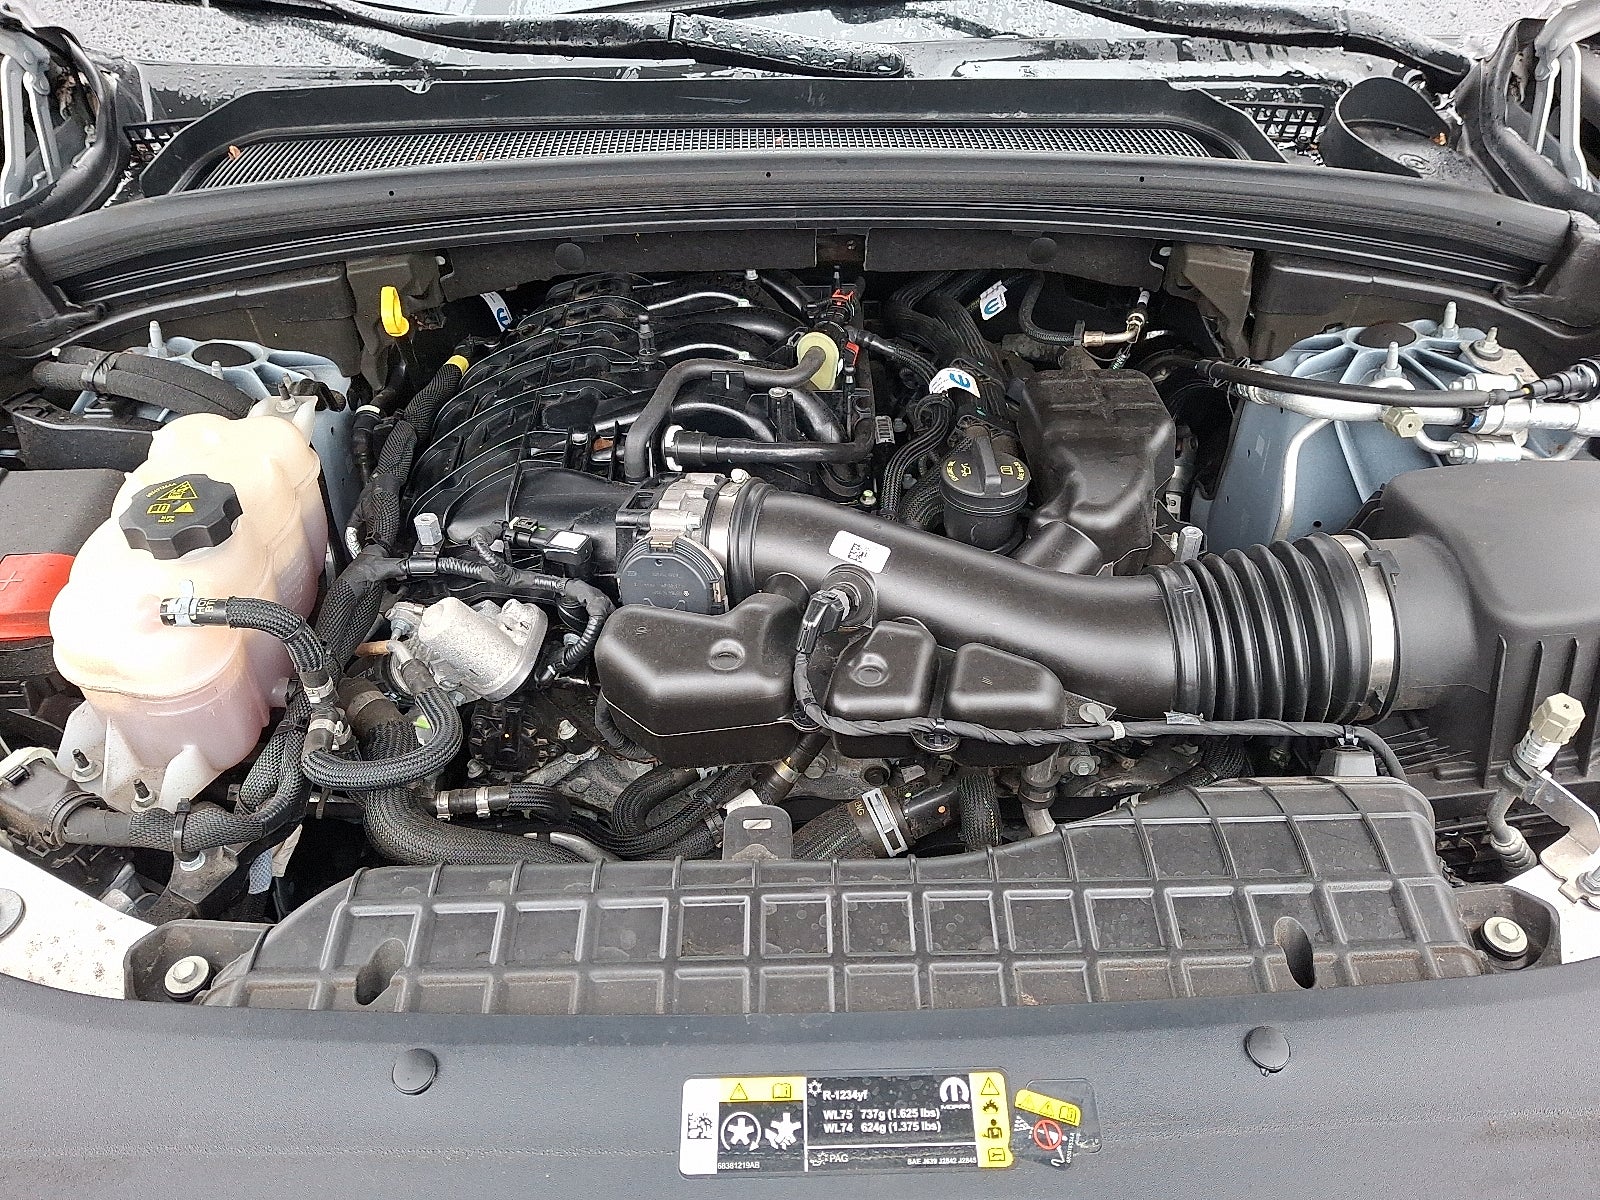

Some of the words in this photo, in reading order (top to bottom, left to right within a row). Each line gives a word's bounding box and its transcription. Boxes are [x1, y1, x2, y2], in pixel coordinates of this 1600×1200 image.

[822, 1089, 868, 1102] R-1234yf
[823, 1110, 853, 1120] WL75
[860, 1109, 886, 1121] 737g
[887, 1108, 919, 1120] (1.625
[920, 1107, 940, 1119] lbs)
[824, 1122, 853, 1133] WL74
[860, 1122, 887, 1134] 624g
[888, 1121, 920, 1133] (1.375
[921, 1121, 941, 1132] lbs)
[829, 1153, 849, 1163] PAG
[717, 1161, 760, 1169] 68381219AB
